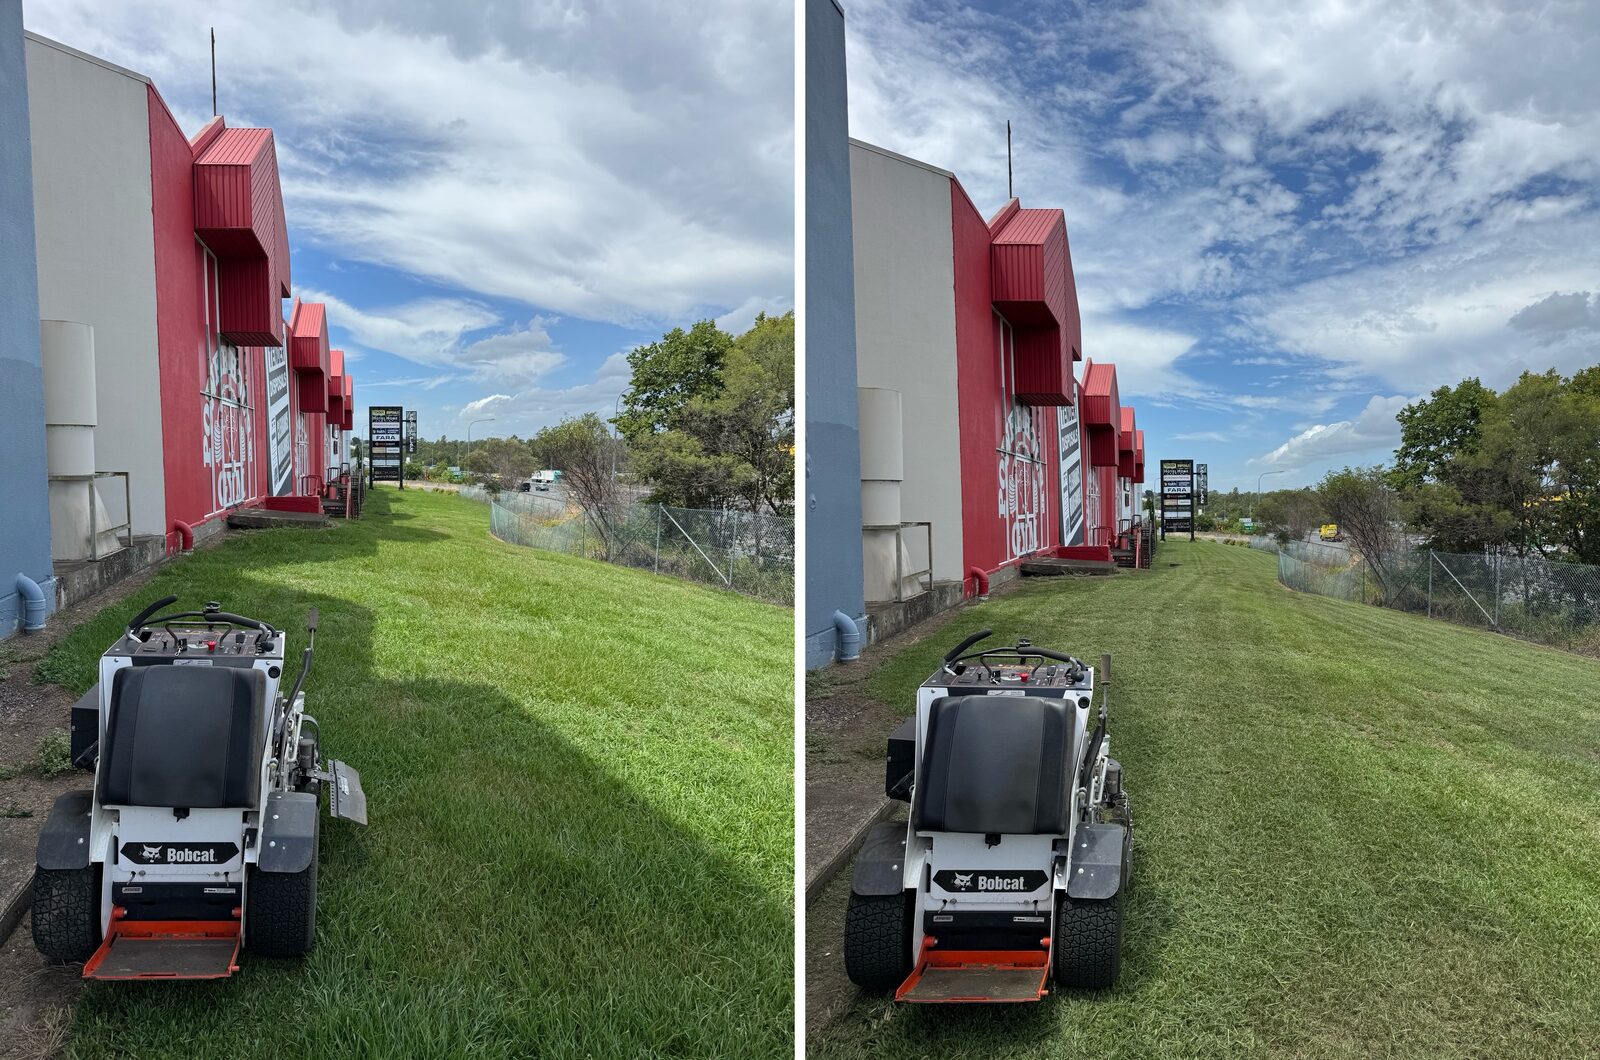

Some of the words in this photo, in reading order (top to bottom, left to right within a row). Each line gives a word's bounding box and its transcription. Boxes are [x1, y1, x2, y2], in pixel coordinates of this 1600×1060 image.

[218, 468, 246, 507] GYM
[1012, 520, 1038, 556] GYM
[167, 848, 215, 862] Bobcat
[978, 876, 1025, 890] Bobcat
